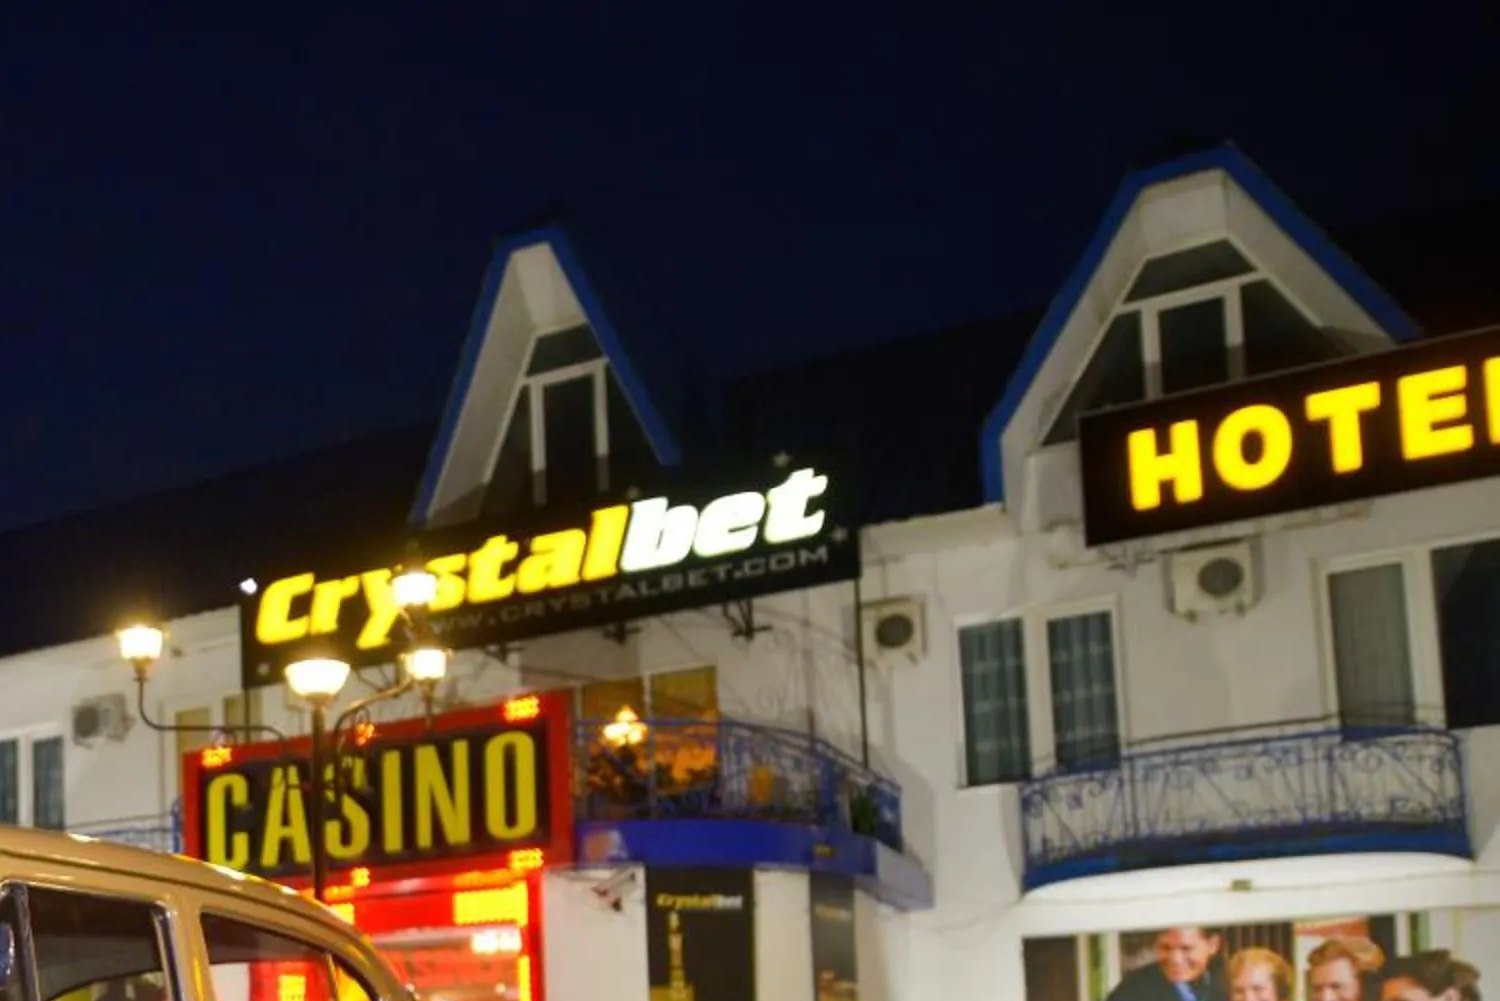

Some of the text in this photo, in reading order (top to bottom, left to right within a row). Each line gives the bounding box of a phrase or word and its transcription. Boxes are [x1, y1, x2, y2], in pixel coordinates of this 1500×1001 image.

[1127, 356, 1500, 511] HOTE
[256, 466, 828, 649] Crystalbet
[206, 730, 537, 871] CASINO
